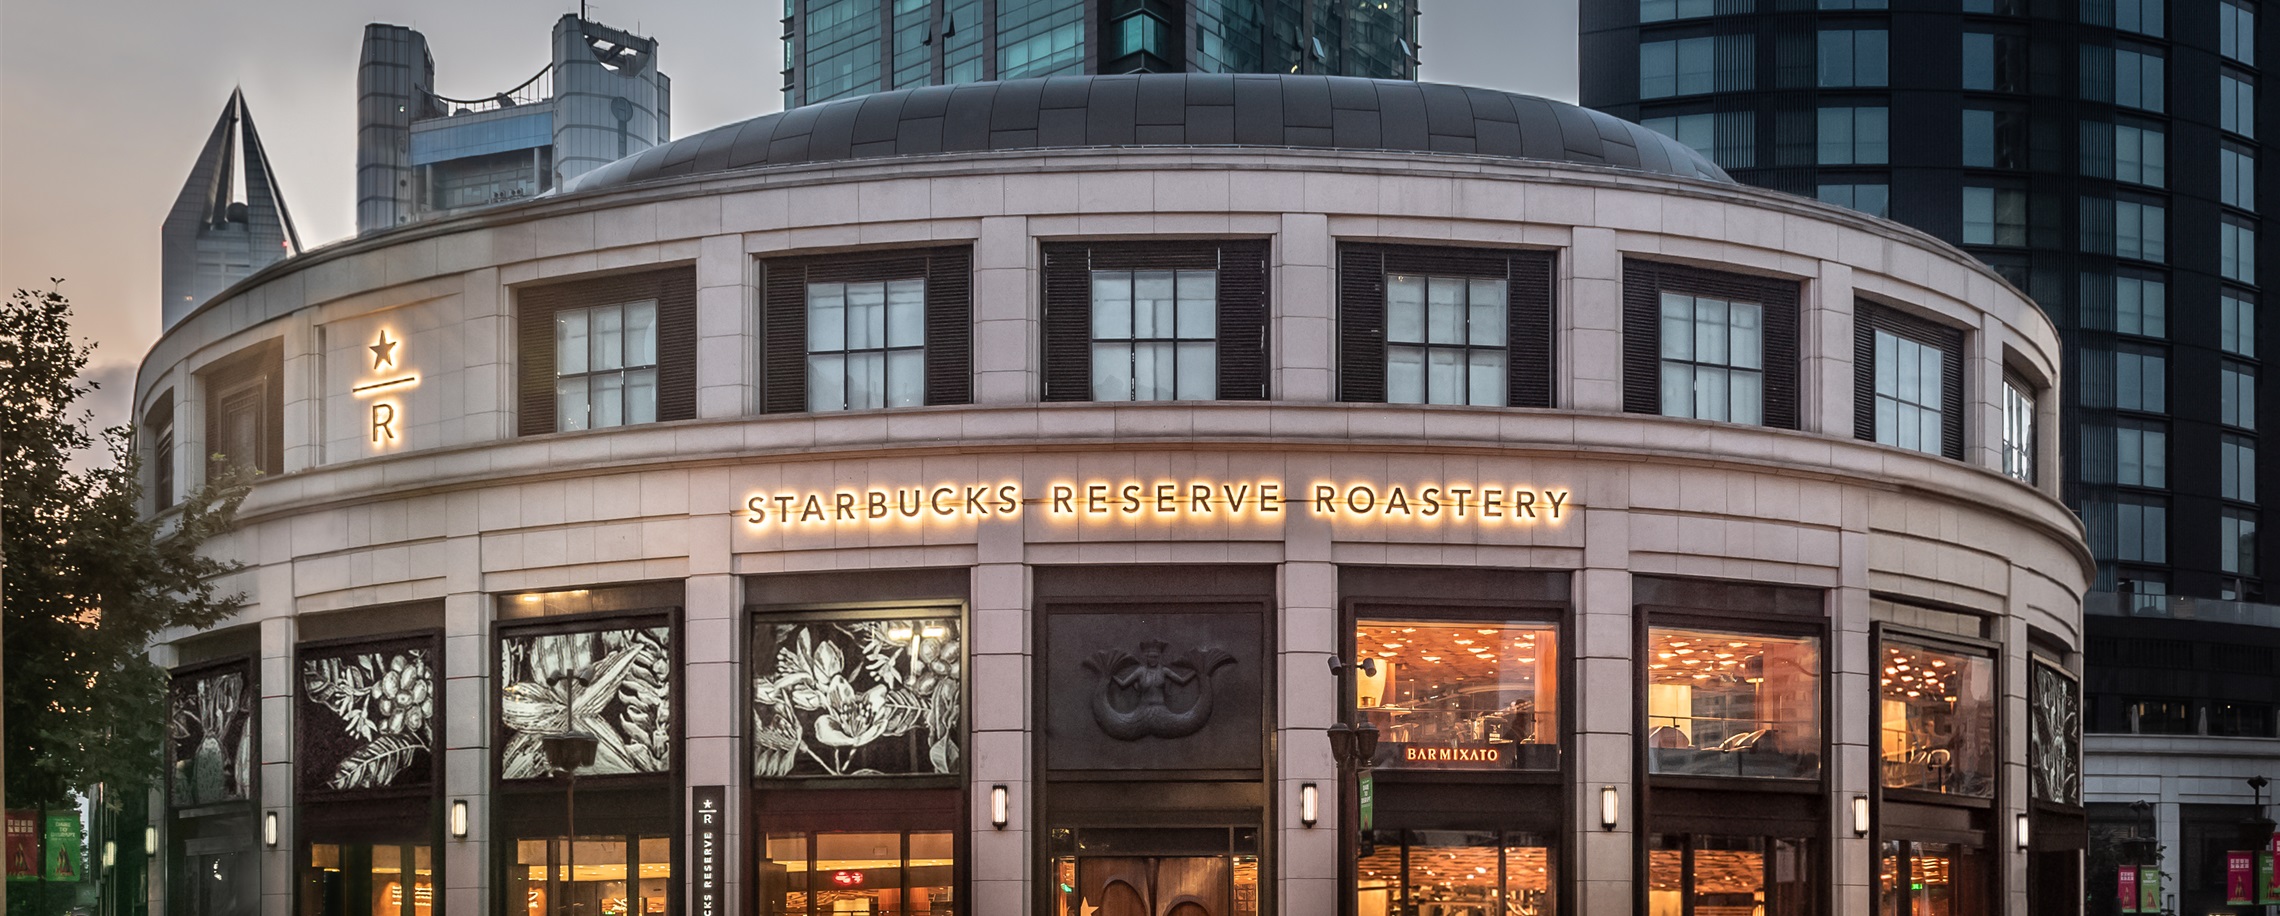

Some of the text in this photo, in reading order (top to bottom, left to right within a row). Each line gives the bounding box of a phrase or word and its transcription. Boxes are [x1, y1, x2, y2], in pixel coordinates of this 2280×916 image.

[372, 403, 394, 442] R
[748, 484, 1568, 524] STARBUCKS RESERVE ROASTERY
[703, 814, 712, 824] R
[703, 832, 713, 888] RESERVE
